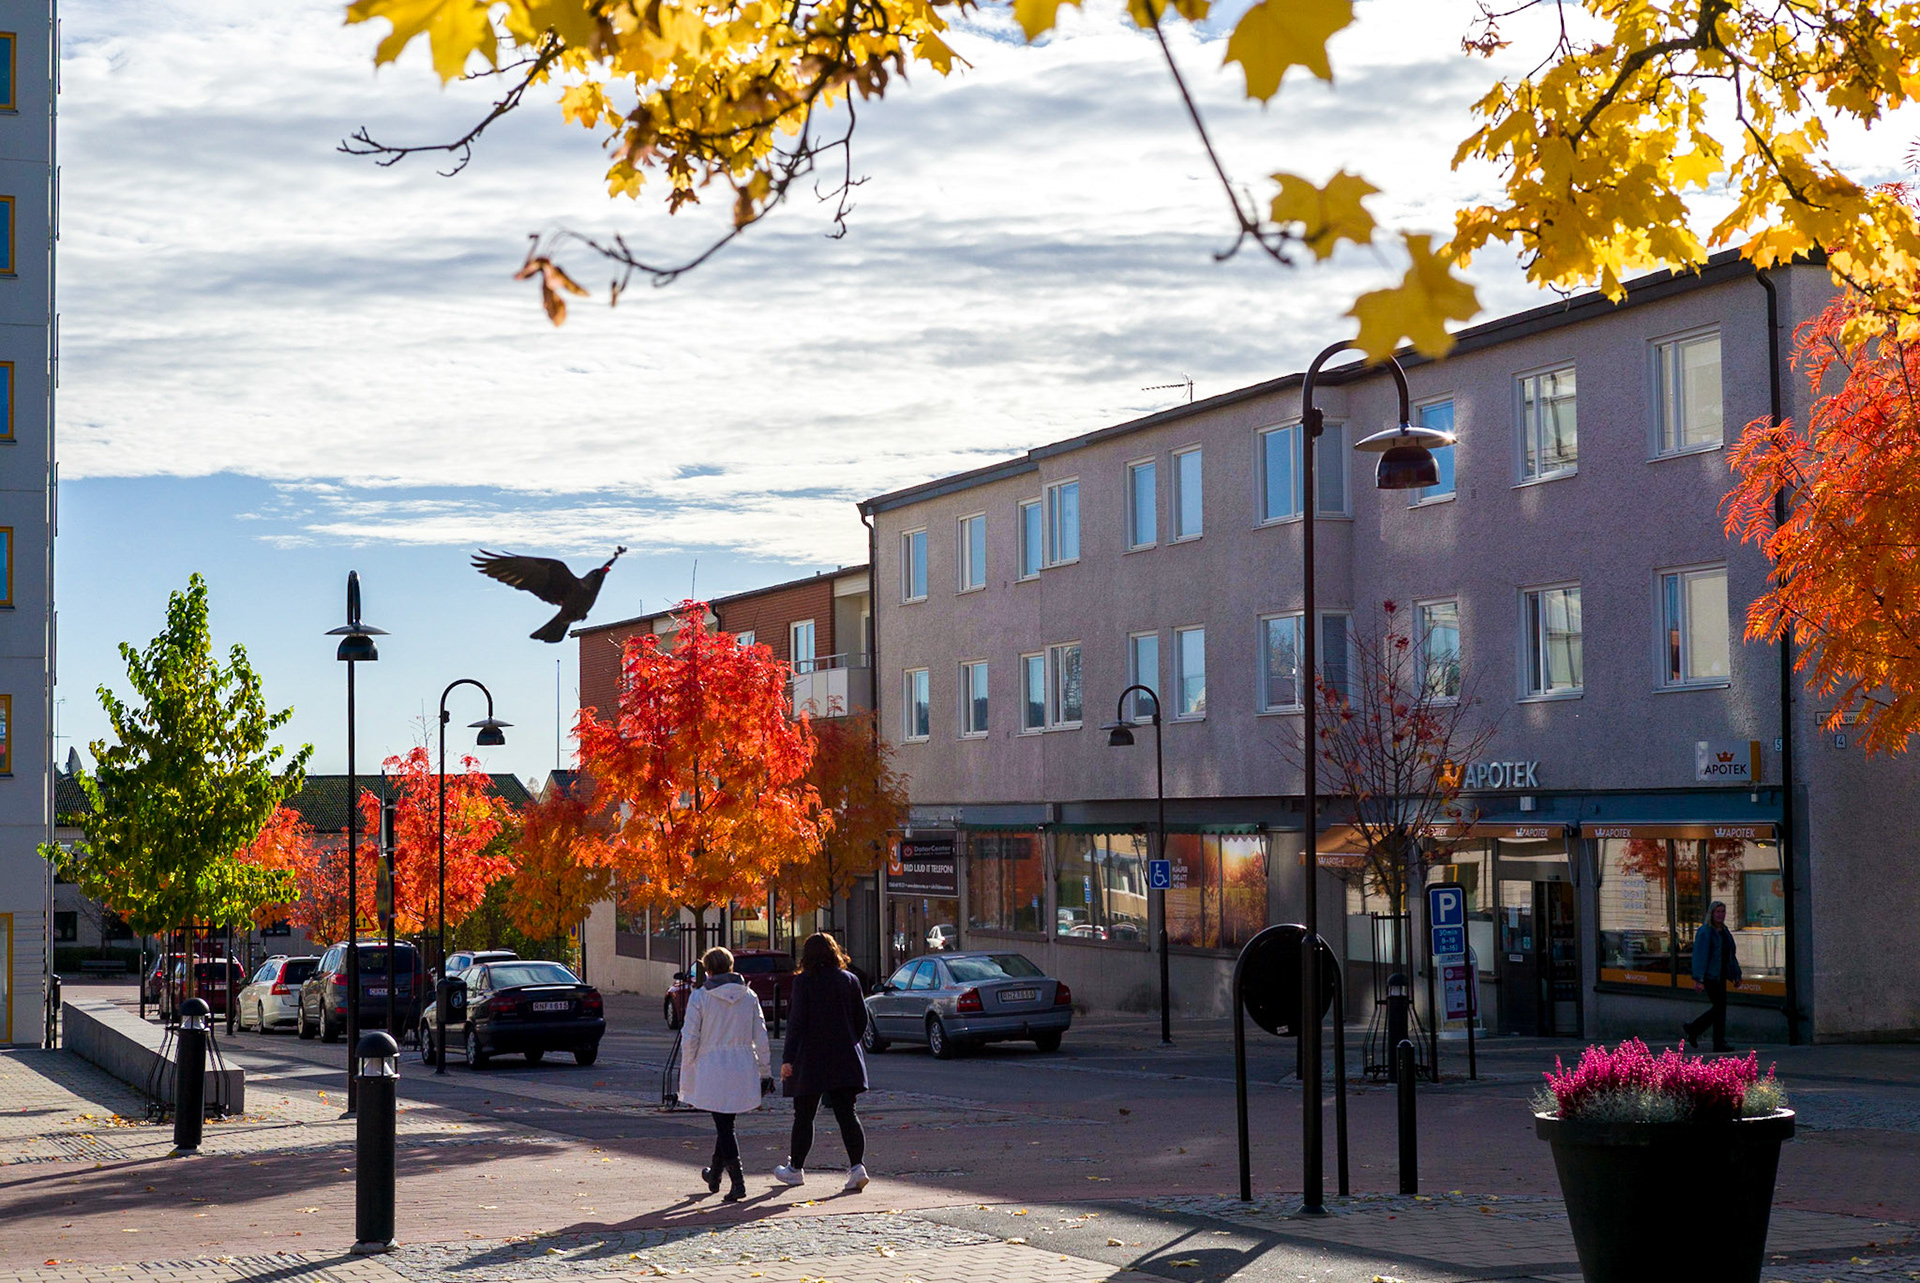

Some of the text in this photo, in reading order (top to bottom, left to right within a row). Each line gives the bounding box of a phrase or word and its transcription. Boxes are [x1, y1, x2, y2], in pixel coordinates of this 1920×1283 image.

[1837, 737, 1843, 745] 4
[1463, 761, 1540, 789] APOTEK
[1704, 764, 1748, 776] APOTEK
[1524, 828, 1549, 837] APOTEK
[1605, 829, 1632, 838] APOTEK
[1725, 828, 1755, 838] APOTEK
[1439, 893, 1457, 923] P
